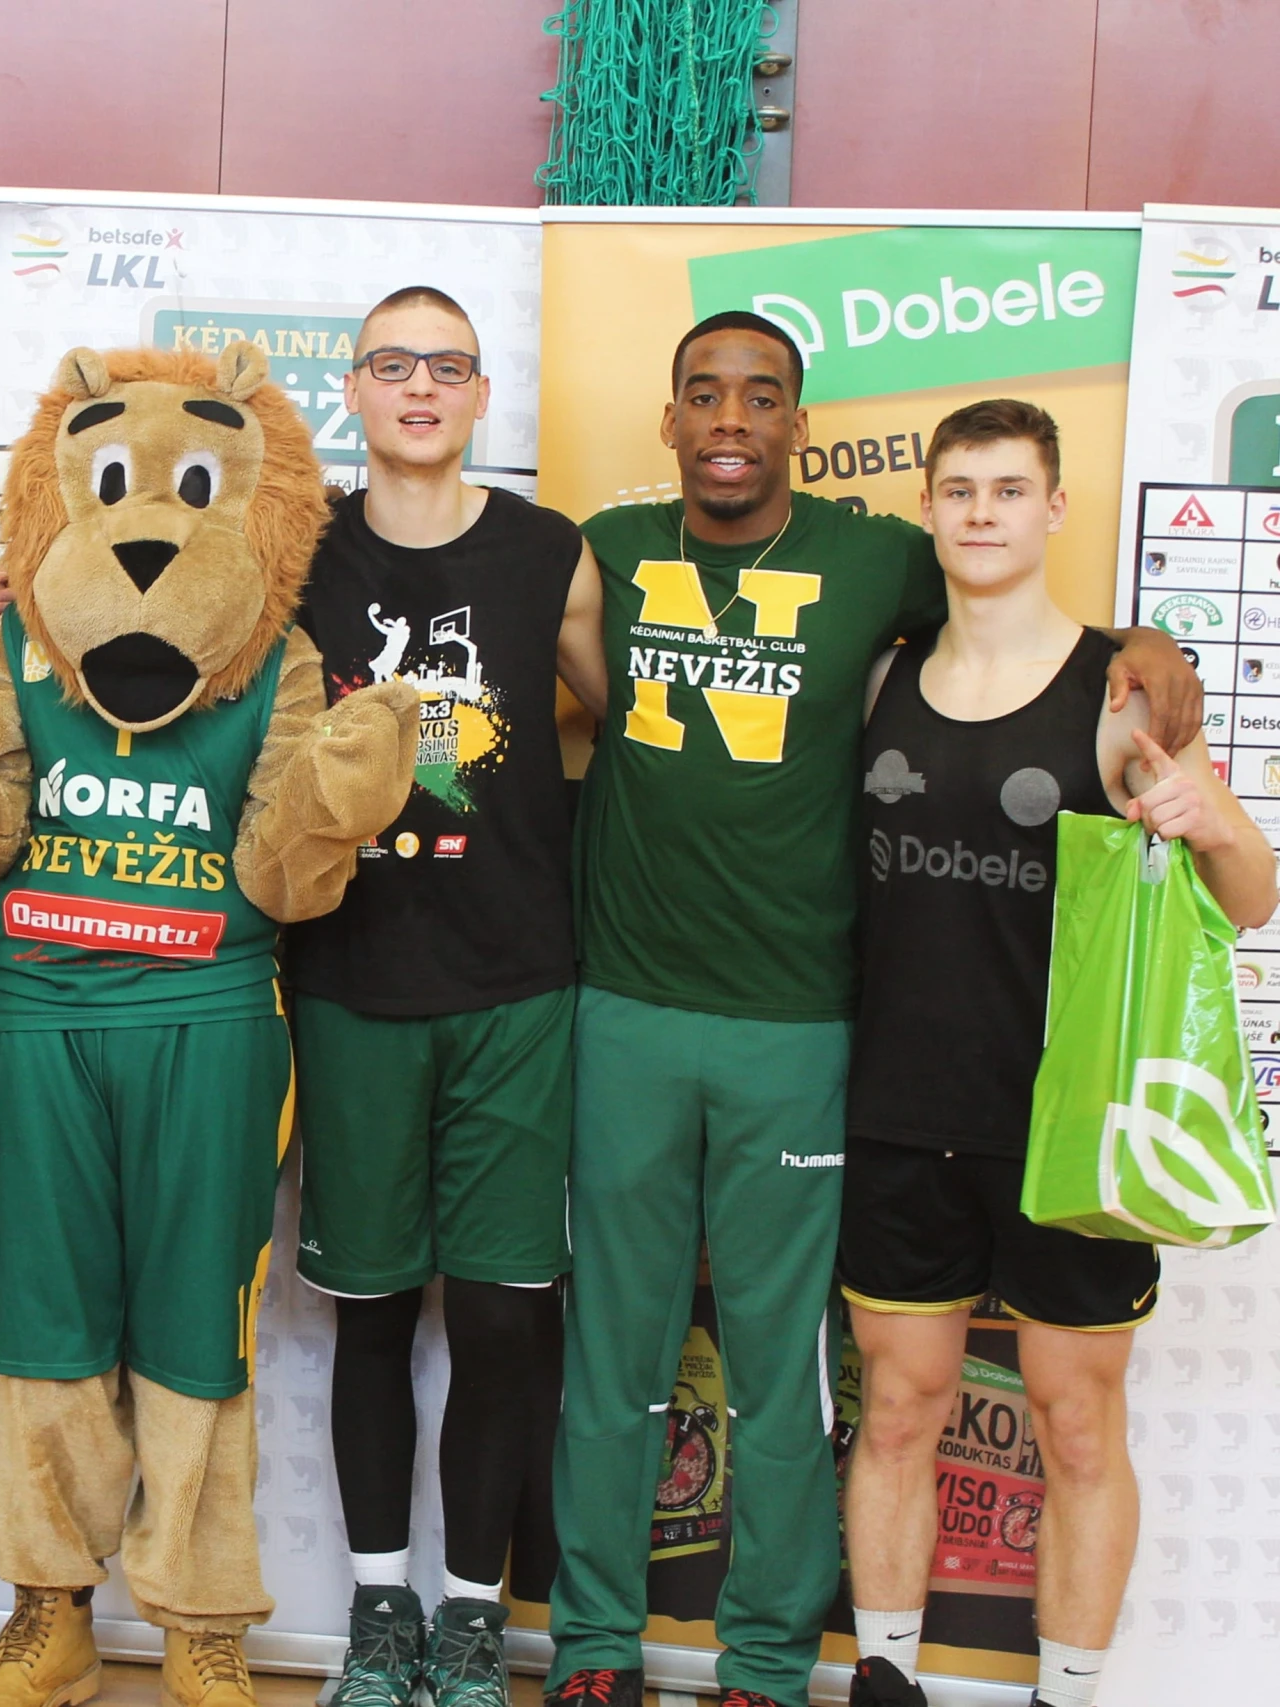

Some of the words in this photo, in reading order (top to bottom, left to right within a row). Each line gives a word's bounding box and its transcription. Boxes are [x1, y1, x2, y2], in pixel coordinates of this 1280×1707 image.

[88, 226, 163, 247] betsafe
[87, 253, 166, 289] LKL
[842, 261, 1105, 349] Dobele
[173, 319, 355, 360] KĖDAINIA
[799, 430, 928, 485] DOBEL
[629, 624, 685, 642] KĖDAINIAI
[687, 633, 767, 651] BASKETBALL
[769, 640, 807, 654] CLUB
[627, 646, 802, 698] NEVĖŽIS
[420, 719, 460, 740] VOS
[38, 759, 211, 832] NORFA
[1255, 816, 1280, 825] Nordi
[22, 830, 226, 892] NEVĖŽIS
[900, 834, 1048, 893] Dobele
[780, 1150, 845, 1168] humme
[937, 1440, 1012, 1470] RODUKTAS
[937, 1505, 993, 1538] ŪDO
